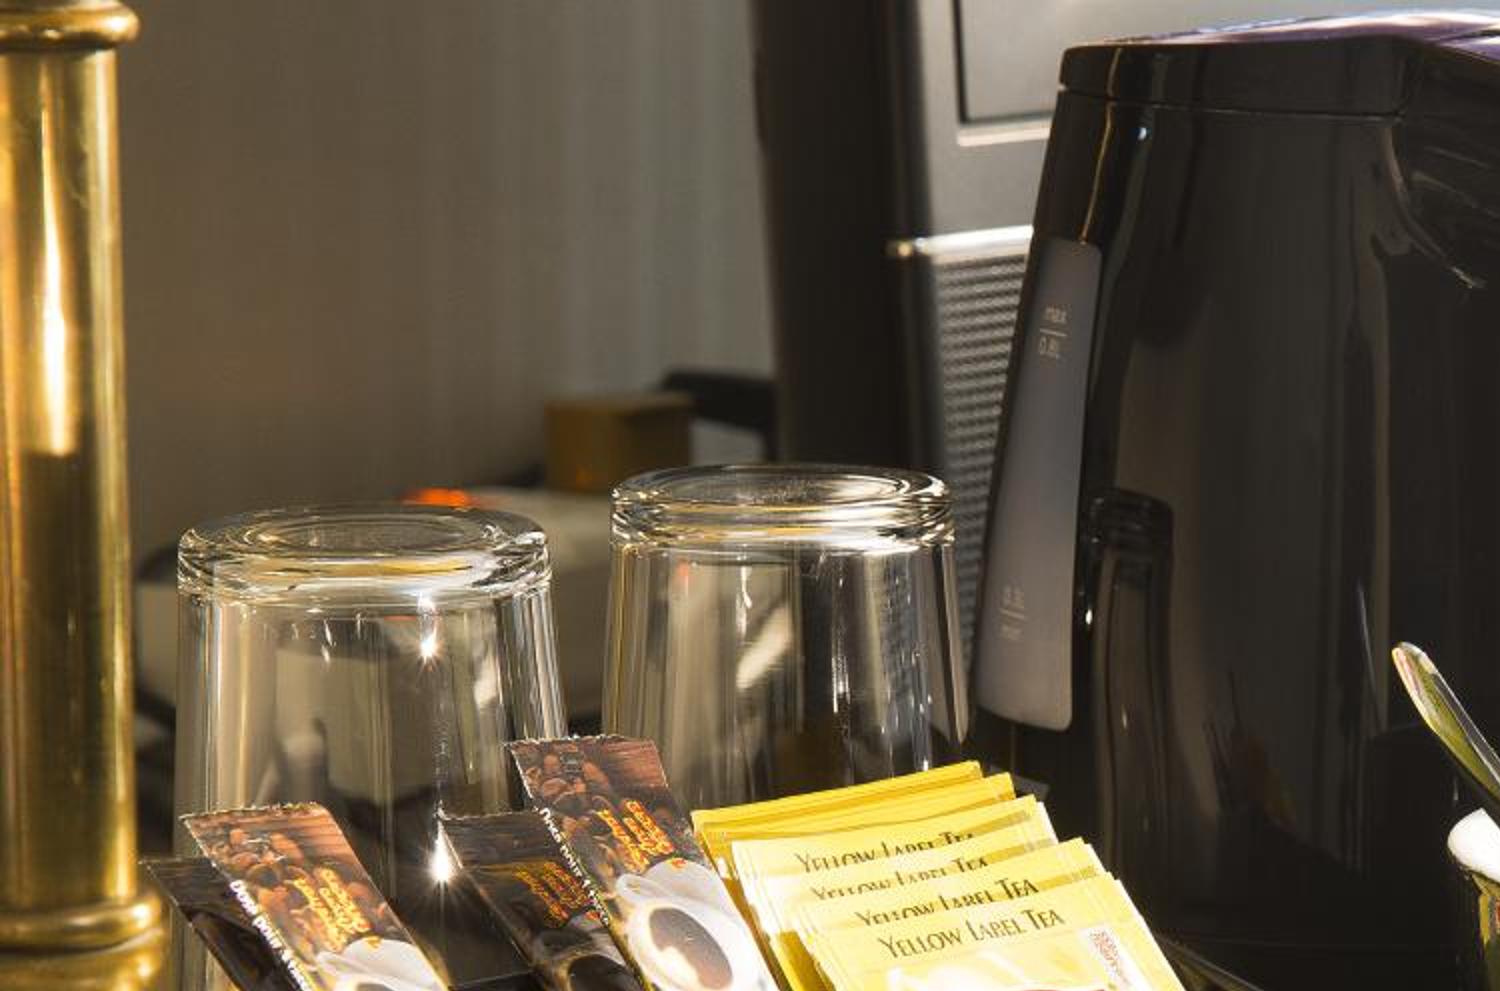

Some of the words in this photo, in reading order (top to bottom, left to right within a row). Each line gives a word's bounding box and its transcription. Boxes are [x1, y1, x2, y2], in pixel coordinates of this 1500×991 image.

[939, 832, 974, 846] TE
[996, 878, 1039, 900] TEA
[878, 930, 962, 959] YELLOW
[966, 917, 1025, 942] LABEL
[1024, 908, 1065, 931] TEA
